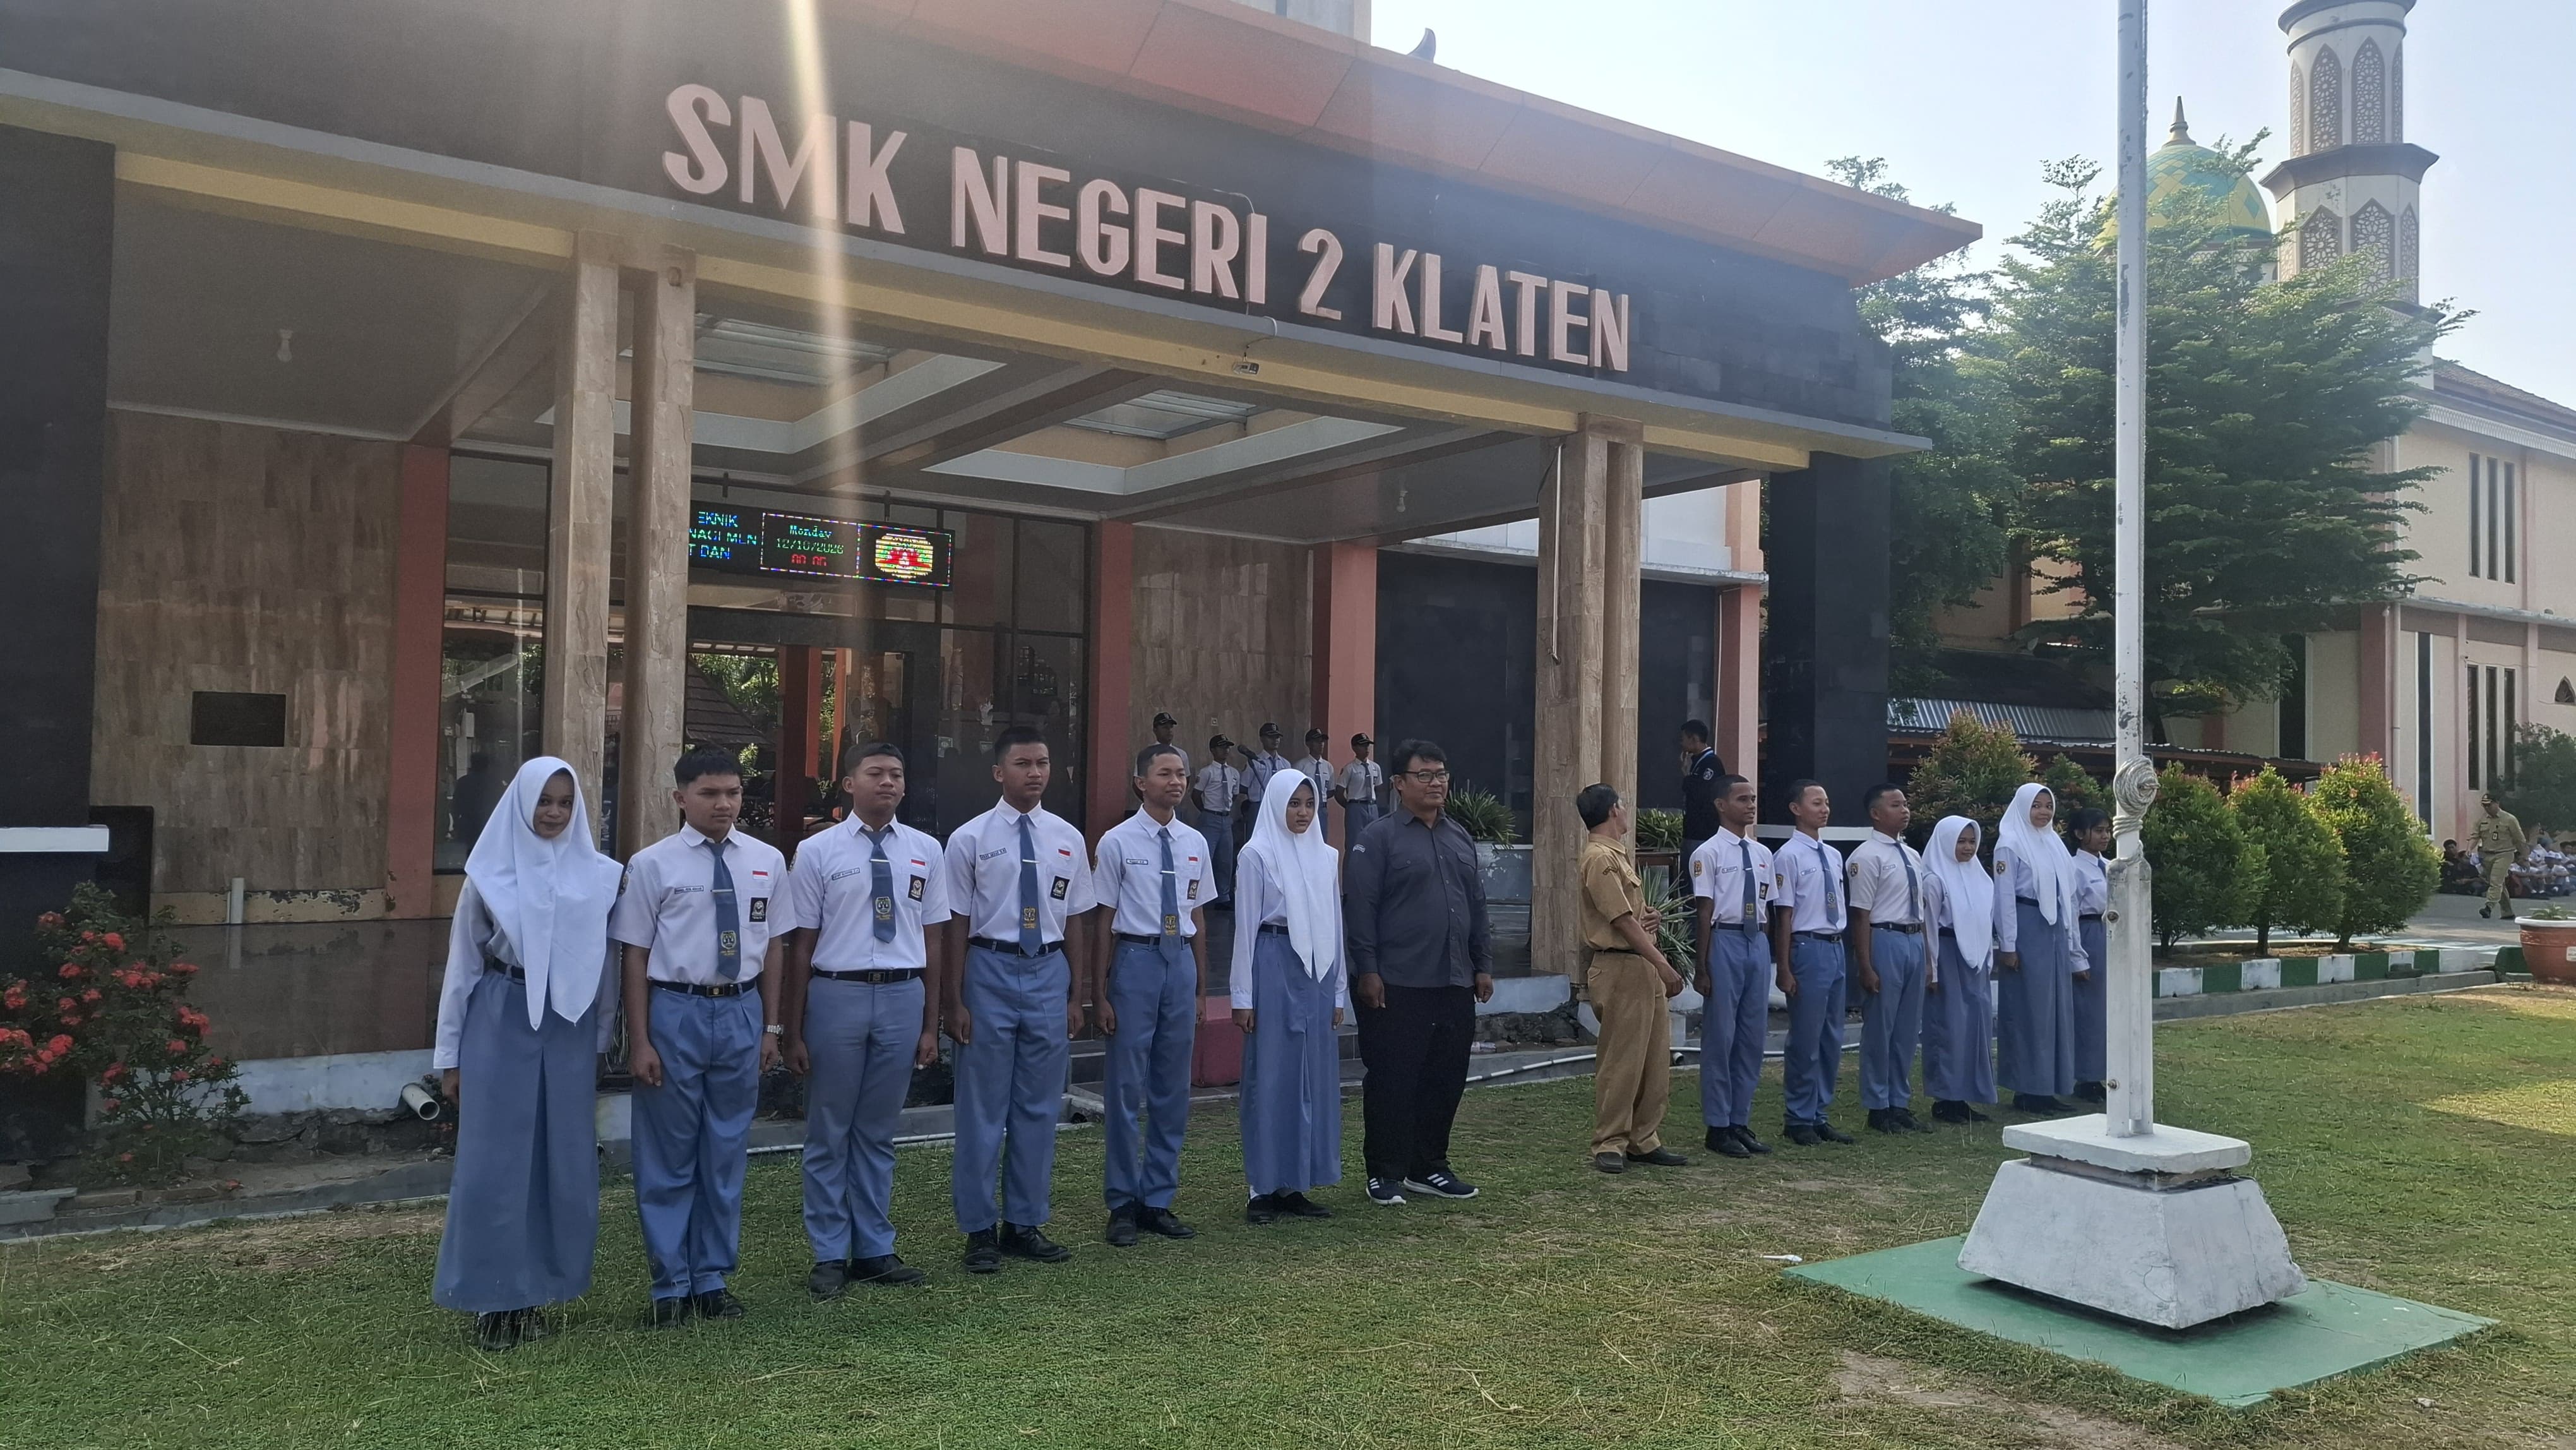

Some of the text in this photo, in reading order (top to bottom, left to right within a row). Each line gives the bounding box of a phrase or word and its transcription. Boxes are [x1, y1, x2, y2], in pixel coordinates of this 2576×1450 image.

[662, 84, 1629, 372] SMK NEGERI 2 KLATEN
[789, 525, 833, 539] Monday
